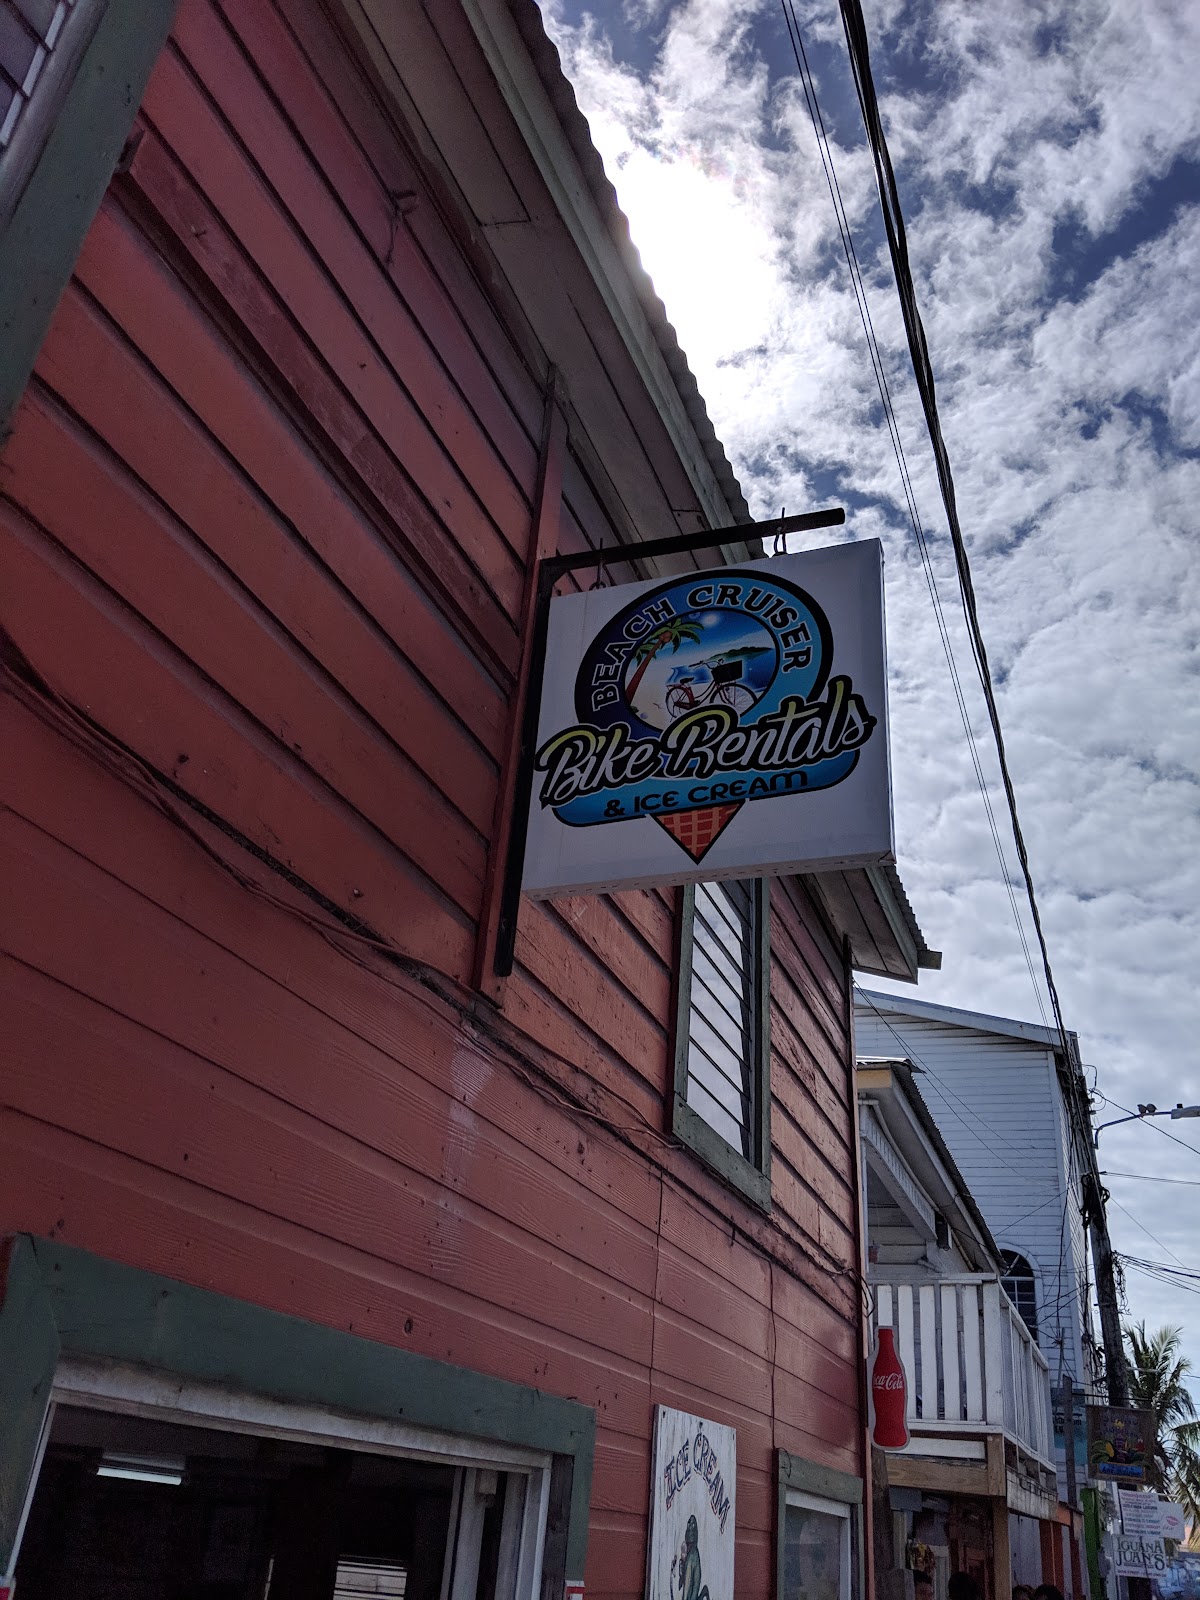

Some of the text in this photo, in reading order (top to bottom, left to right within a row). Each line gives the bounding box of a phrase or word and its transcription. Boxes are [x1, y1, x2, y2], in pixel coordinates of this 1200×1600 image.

[591, 582, 813, 711] BEACH CRUISER
[536, 679, 869, 805] Bike Rentals
[603, 770, 808, 818] & ICE CREAM
[873, 1373, 903, 1391] ca-Cola
[664, 1432, 730, 1535] ICE CREAM
[1115, 1551, 1165, 1571] JUAN'S
[1116, 1537, 1163, 1553] IGUANA
